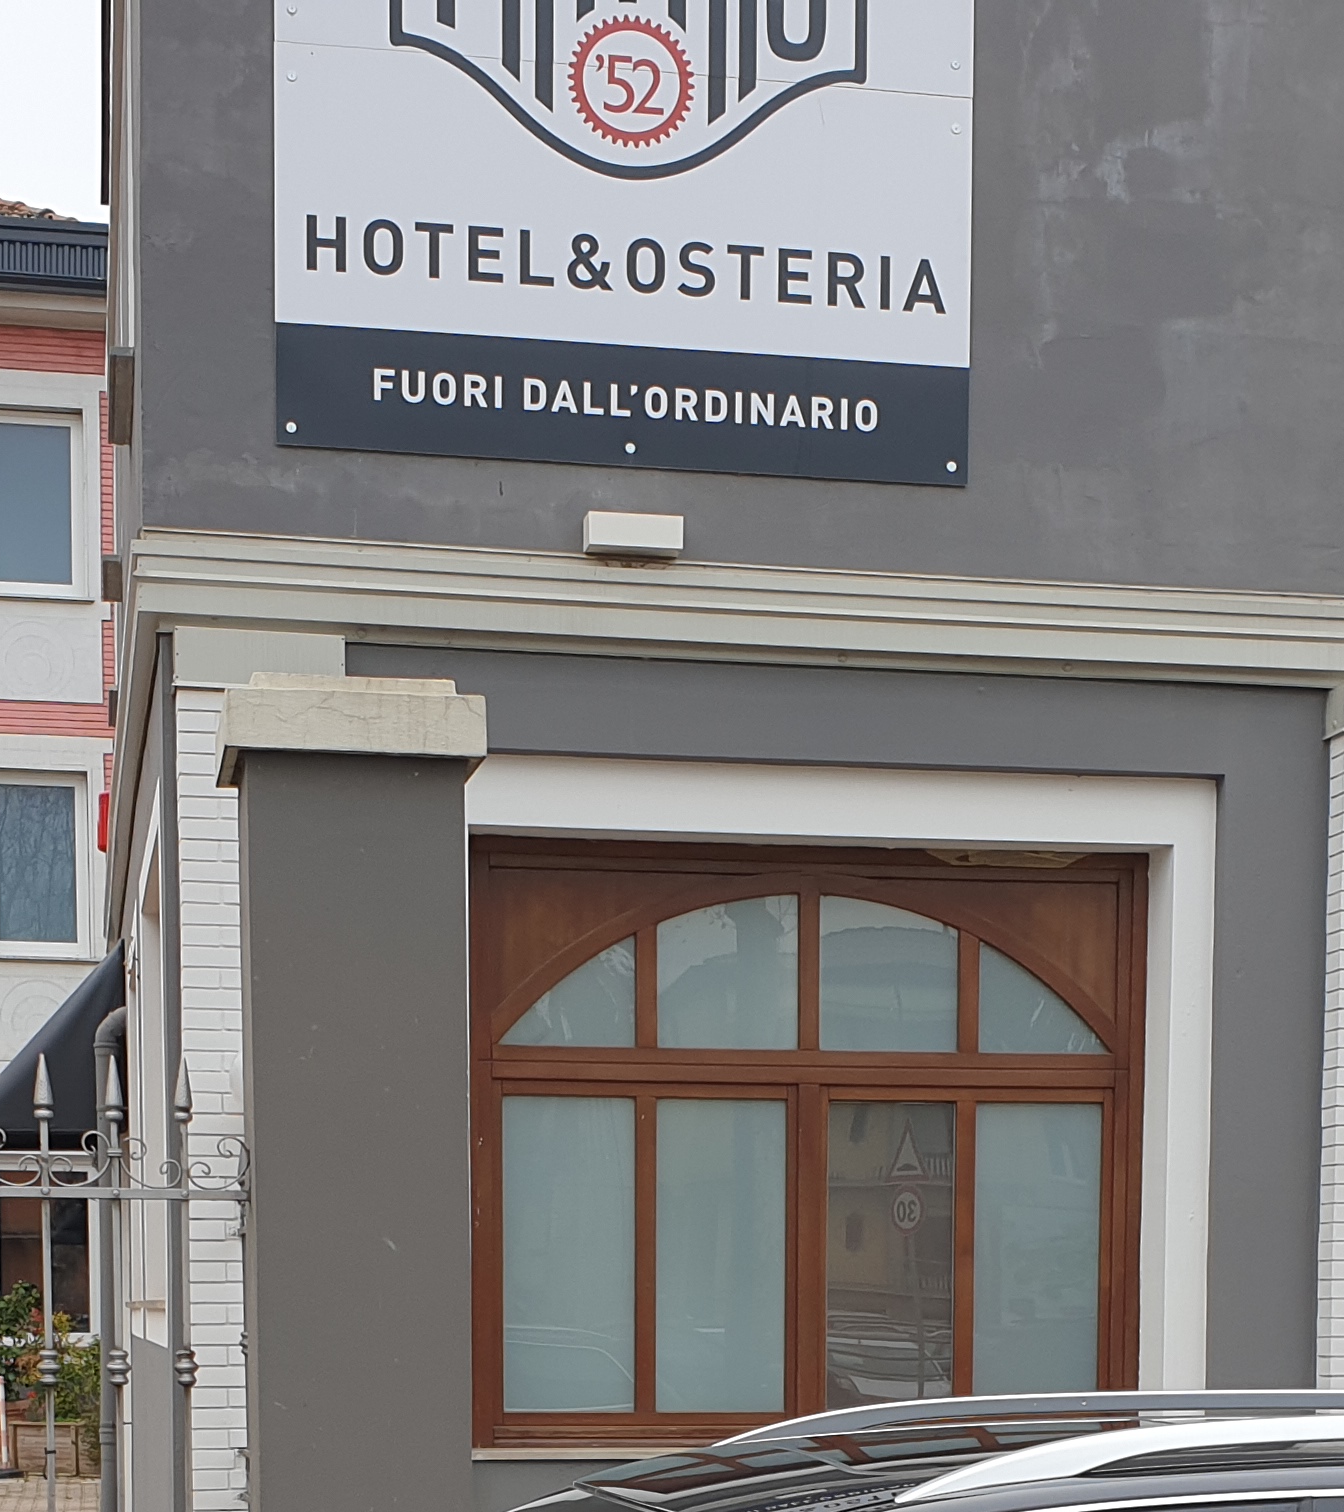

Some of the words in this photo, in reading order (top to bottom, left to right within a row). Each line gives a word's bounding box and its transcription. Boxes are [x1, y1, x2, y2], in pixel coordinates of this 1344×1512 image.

[594, 54, 665, 117] '52
[304, 213, 948, 315] HOTEL&OSTERIA
[372, 367, 504, 410] FUORI
[523, 377, 879, 433] DALL'ORDINARIO
